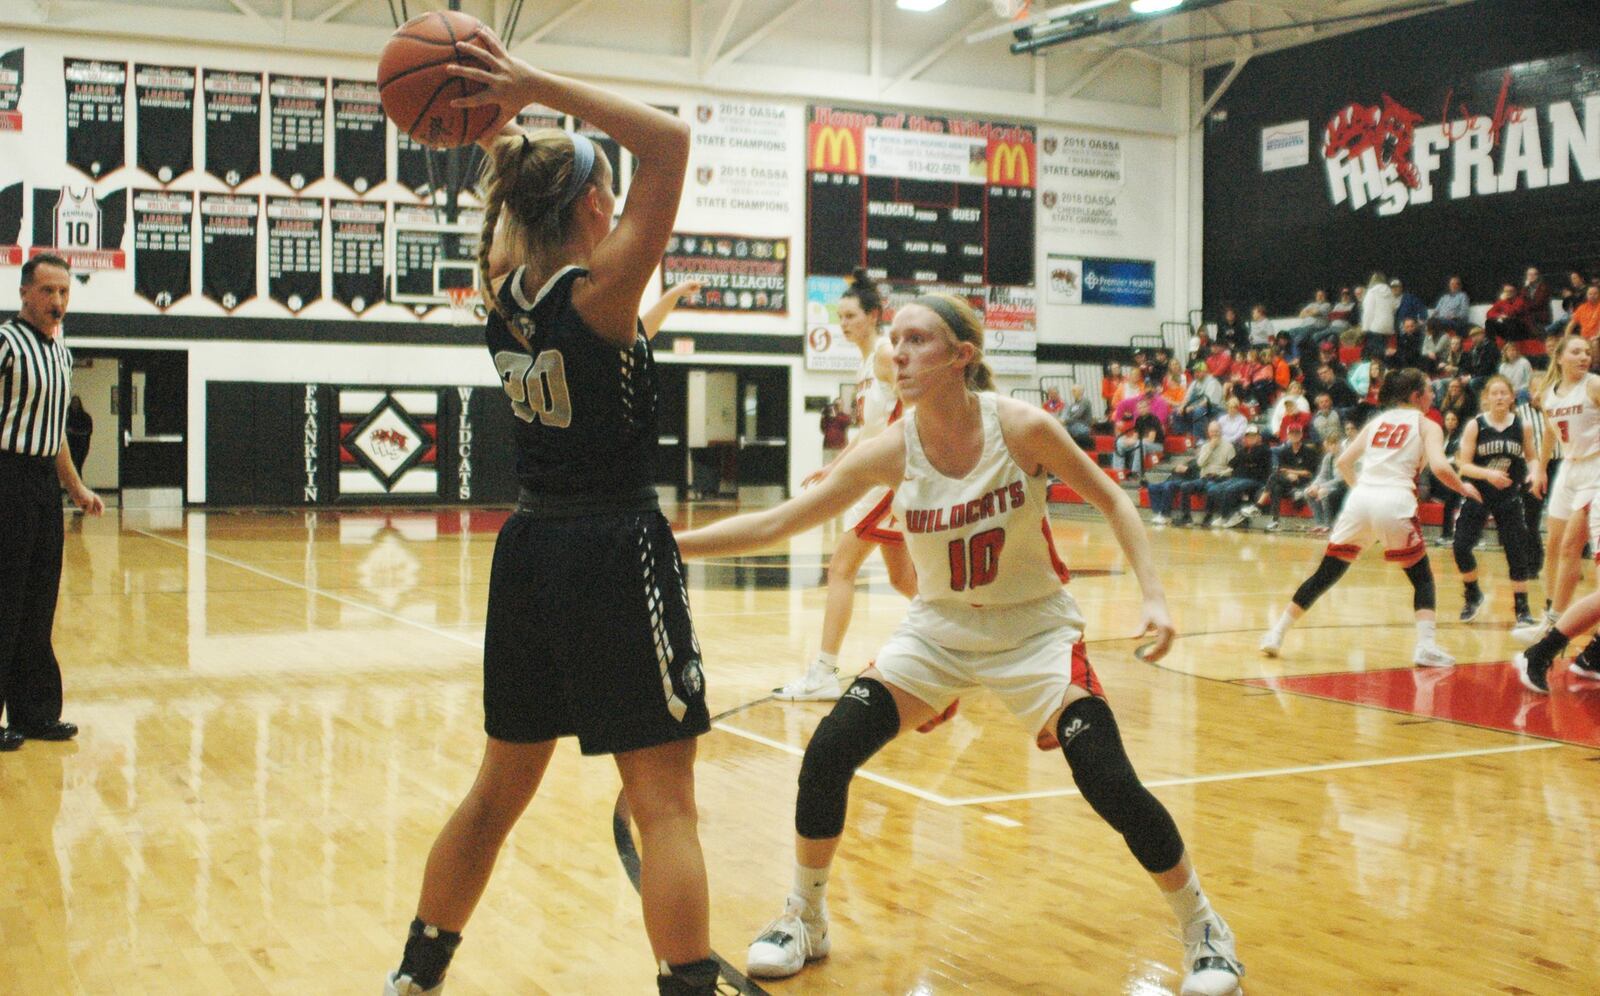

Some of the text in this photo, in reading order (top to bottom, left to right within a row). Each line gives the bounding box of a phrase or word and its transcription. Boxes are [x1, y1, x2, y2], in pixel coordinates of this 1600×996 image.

[815, 106, 1035, 145] Home of the Wildcats
[695, 134, 788, 153] STATE CHAMPIONS
[1043, 165, 1121, 181] STATE CHAMPIONS
[694, 196, 791, 214] STATE CHAMPIONS
[868, 201, 915, 217] WILDCATS
[952, 207, 981, 222] GUEST
[65, 221, 90, 247] 10
[731, 275, 785, 290] LEAGUE
[1129, 278, 1155, 290] Health
[304, 384, 318, 502] FRANKLIN
[456, 386, 474, 500] WILDCATS
[1371, 422, 1412, 449] 20
[905, 480, 1026, 534] WILDCATS
[948, 526, 1006, 592] 10
